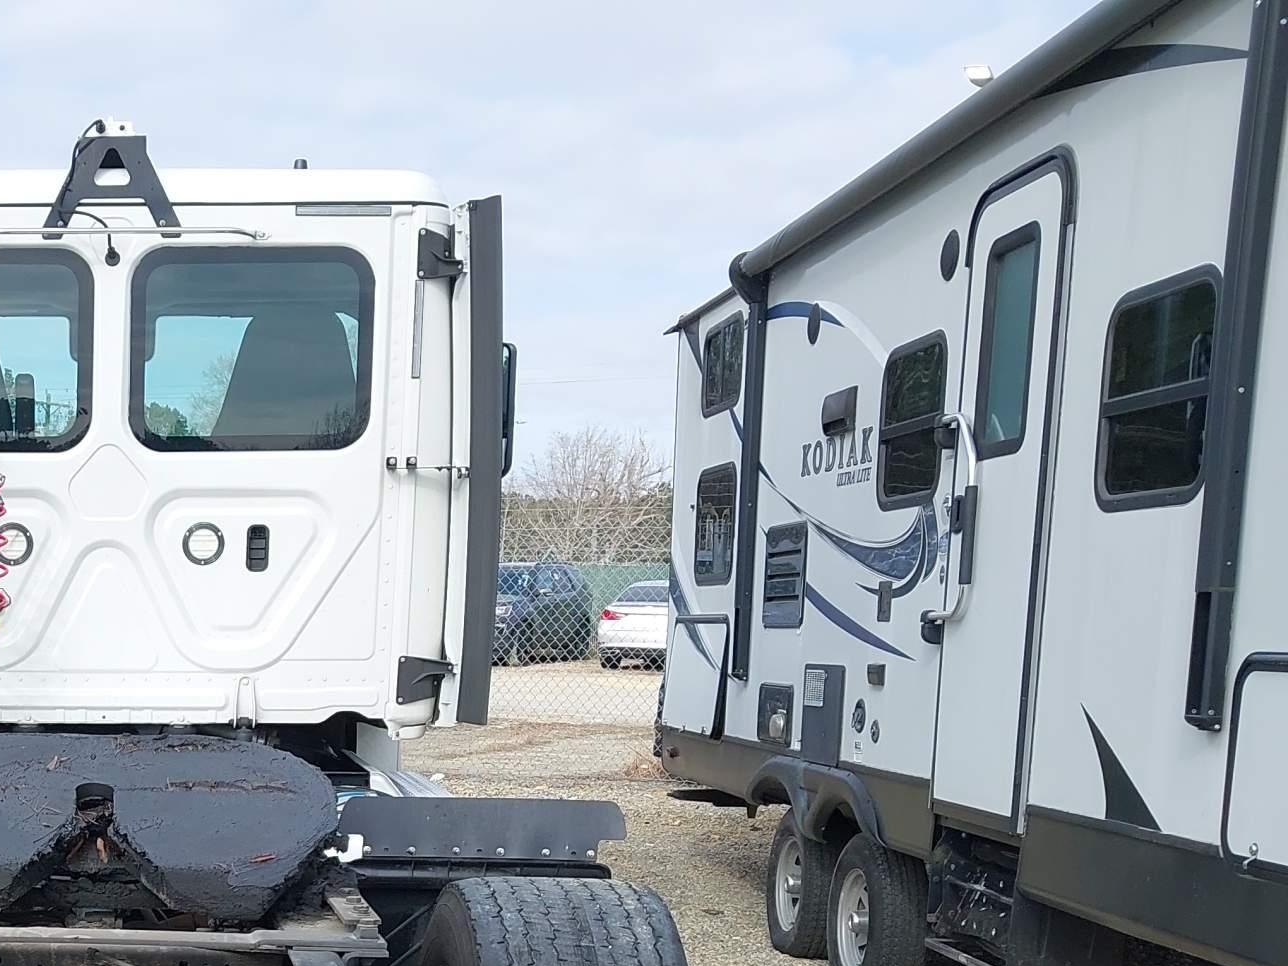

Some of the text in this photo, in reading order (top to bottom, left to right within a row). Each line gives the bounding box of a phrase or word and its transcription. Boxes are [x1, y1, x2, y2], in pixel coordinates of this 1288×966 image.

[800, 427, 873, 477] KODIAK
[836, 467, 872, 487] ULTRA LITE
